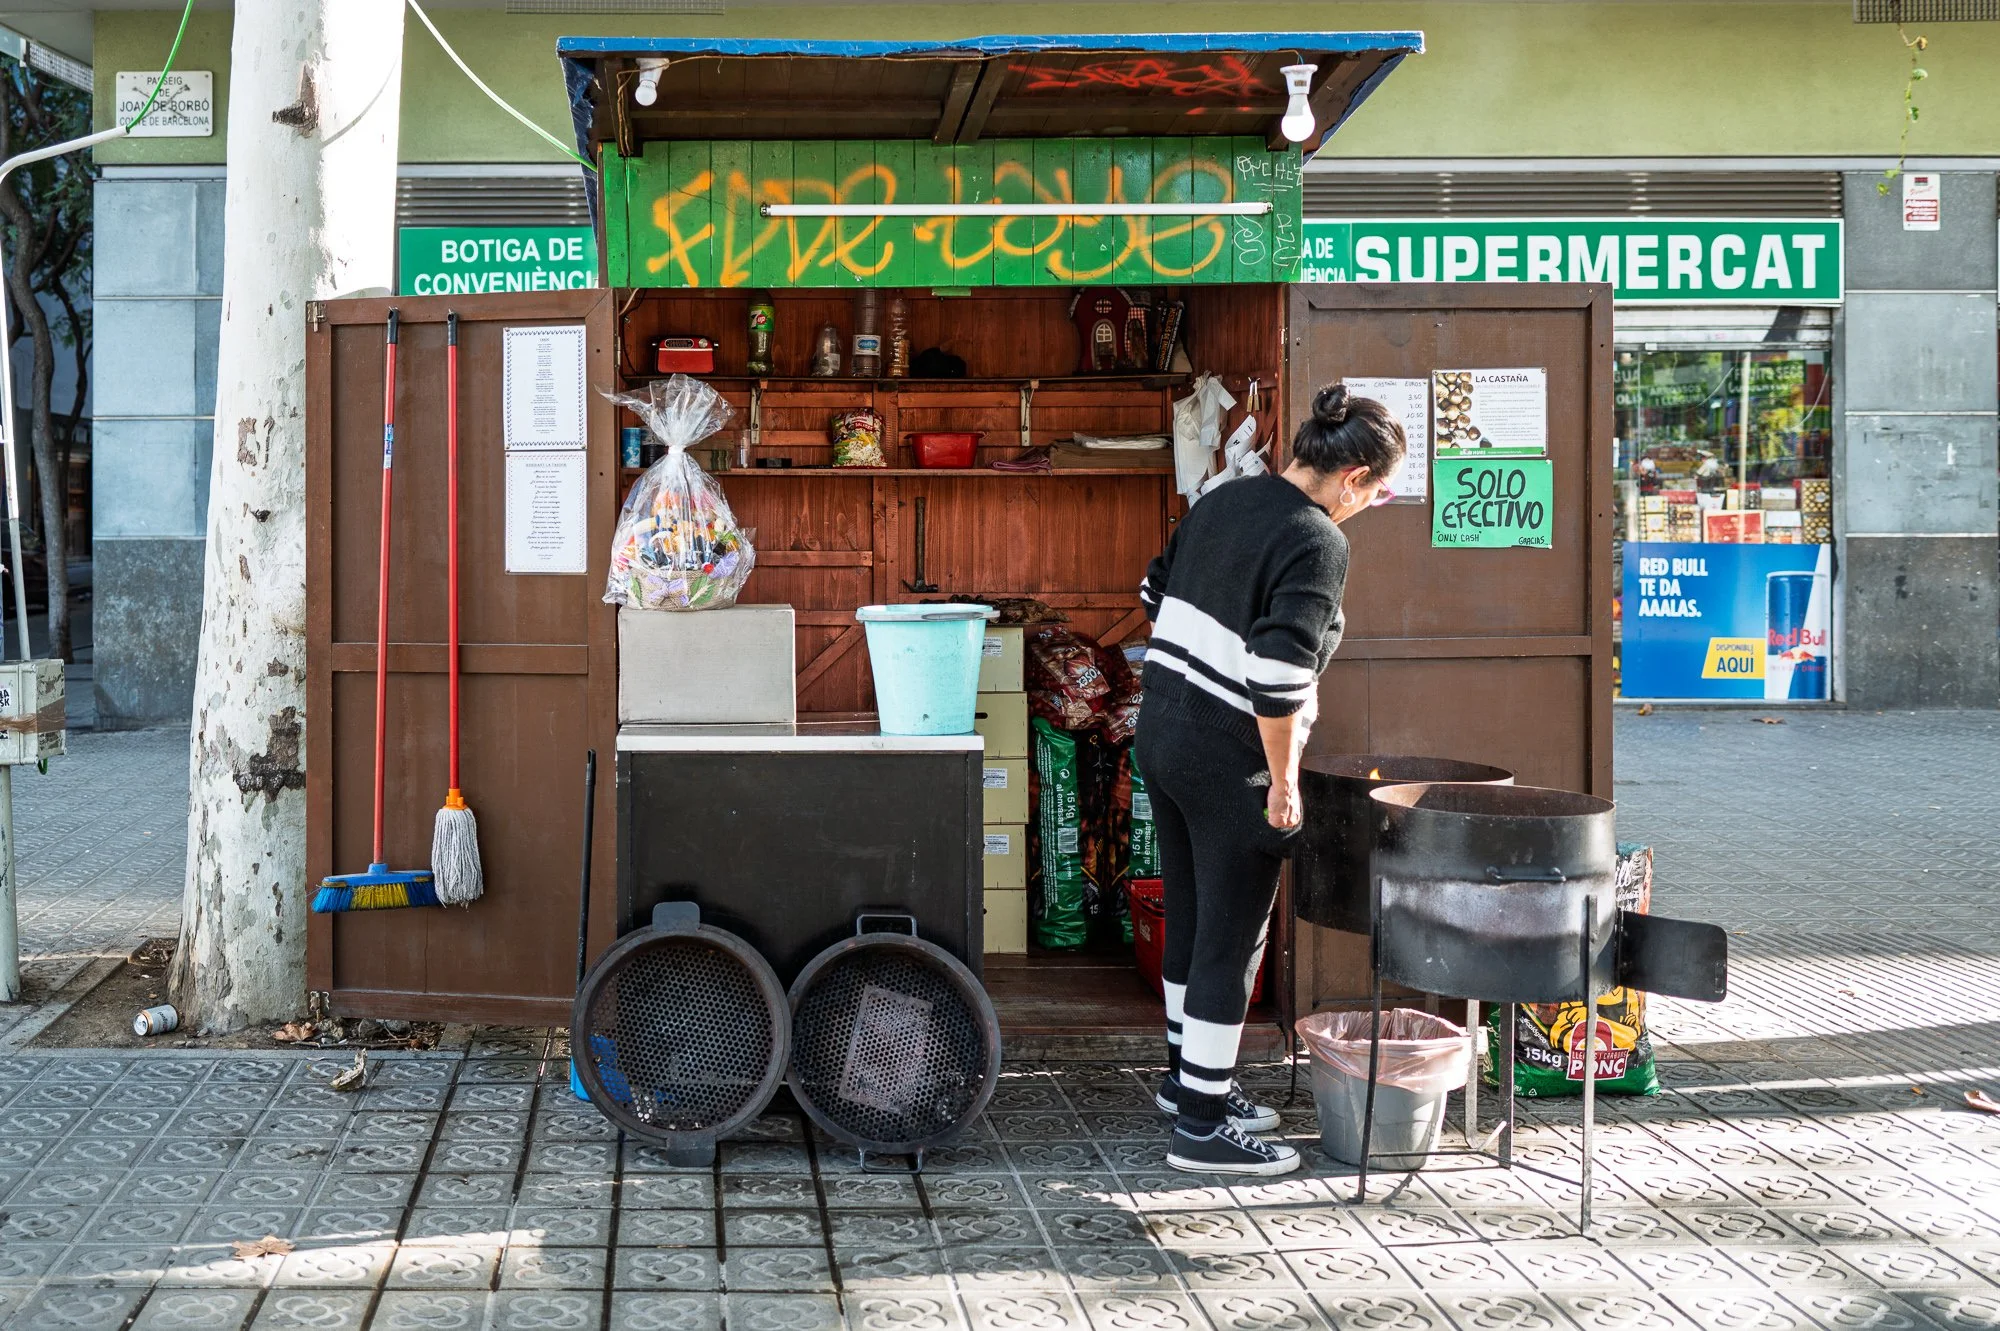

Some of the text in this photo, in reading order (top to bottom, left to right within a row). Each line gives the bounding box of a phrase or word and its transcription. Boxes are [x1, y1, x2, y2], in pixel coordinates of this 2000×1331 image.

[159, 88, 170, 97] DE
[152, 101, 167, 112] DE
[170, 97, 210, 112] BORBÓ
[120, 116, 210, 126] COE DE BARCELONA
[441, 237, 584, 263] BOTIGA DE
[1316, 237, 1334, 258] DE
[1355, 234, 1826, 290] SUPERMERCAT
[414, 266, 599, 296] CONVENIÈNCI
[1475, 373, 1529, 383] LA CASTAÑA
[1457, 467, 1526, 499] SOLO
[1442, 500, 1544, 529] EFECTIVO
[1518, 536, 1545, 545] GRACIAS
[1639, 557, 1708, 576] RED BULL
[1639, 578, 1681, 596] TE DA
[1638, 599, 1702, 617] AAALAS.
[1768, 627, 1826, 646] Red Bul
[1055, 783, 1064, 827] al envasar
[1065, 790, 1076, 819] 15 Kg
[1132, 828, 1143, 856] 15 Kg
[1143, 821, 1152, 865] al envasar
[1523, 1046, 1562, 1068] 15kg
